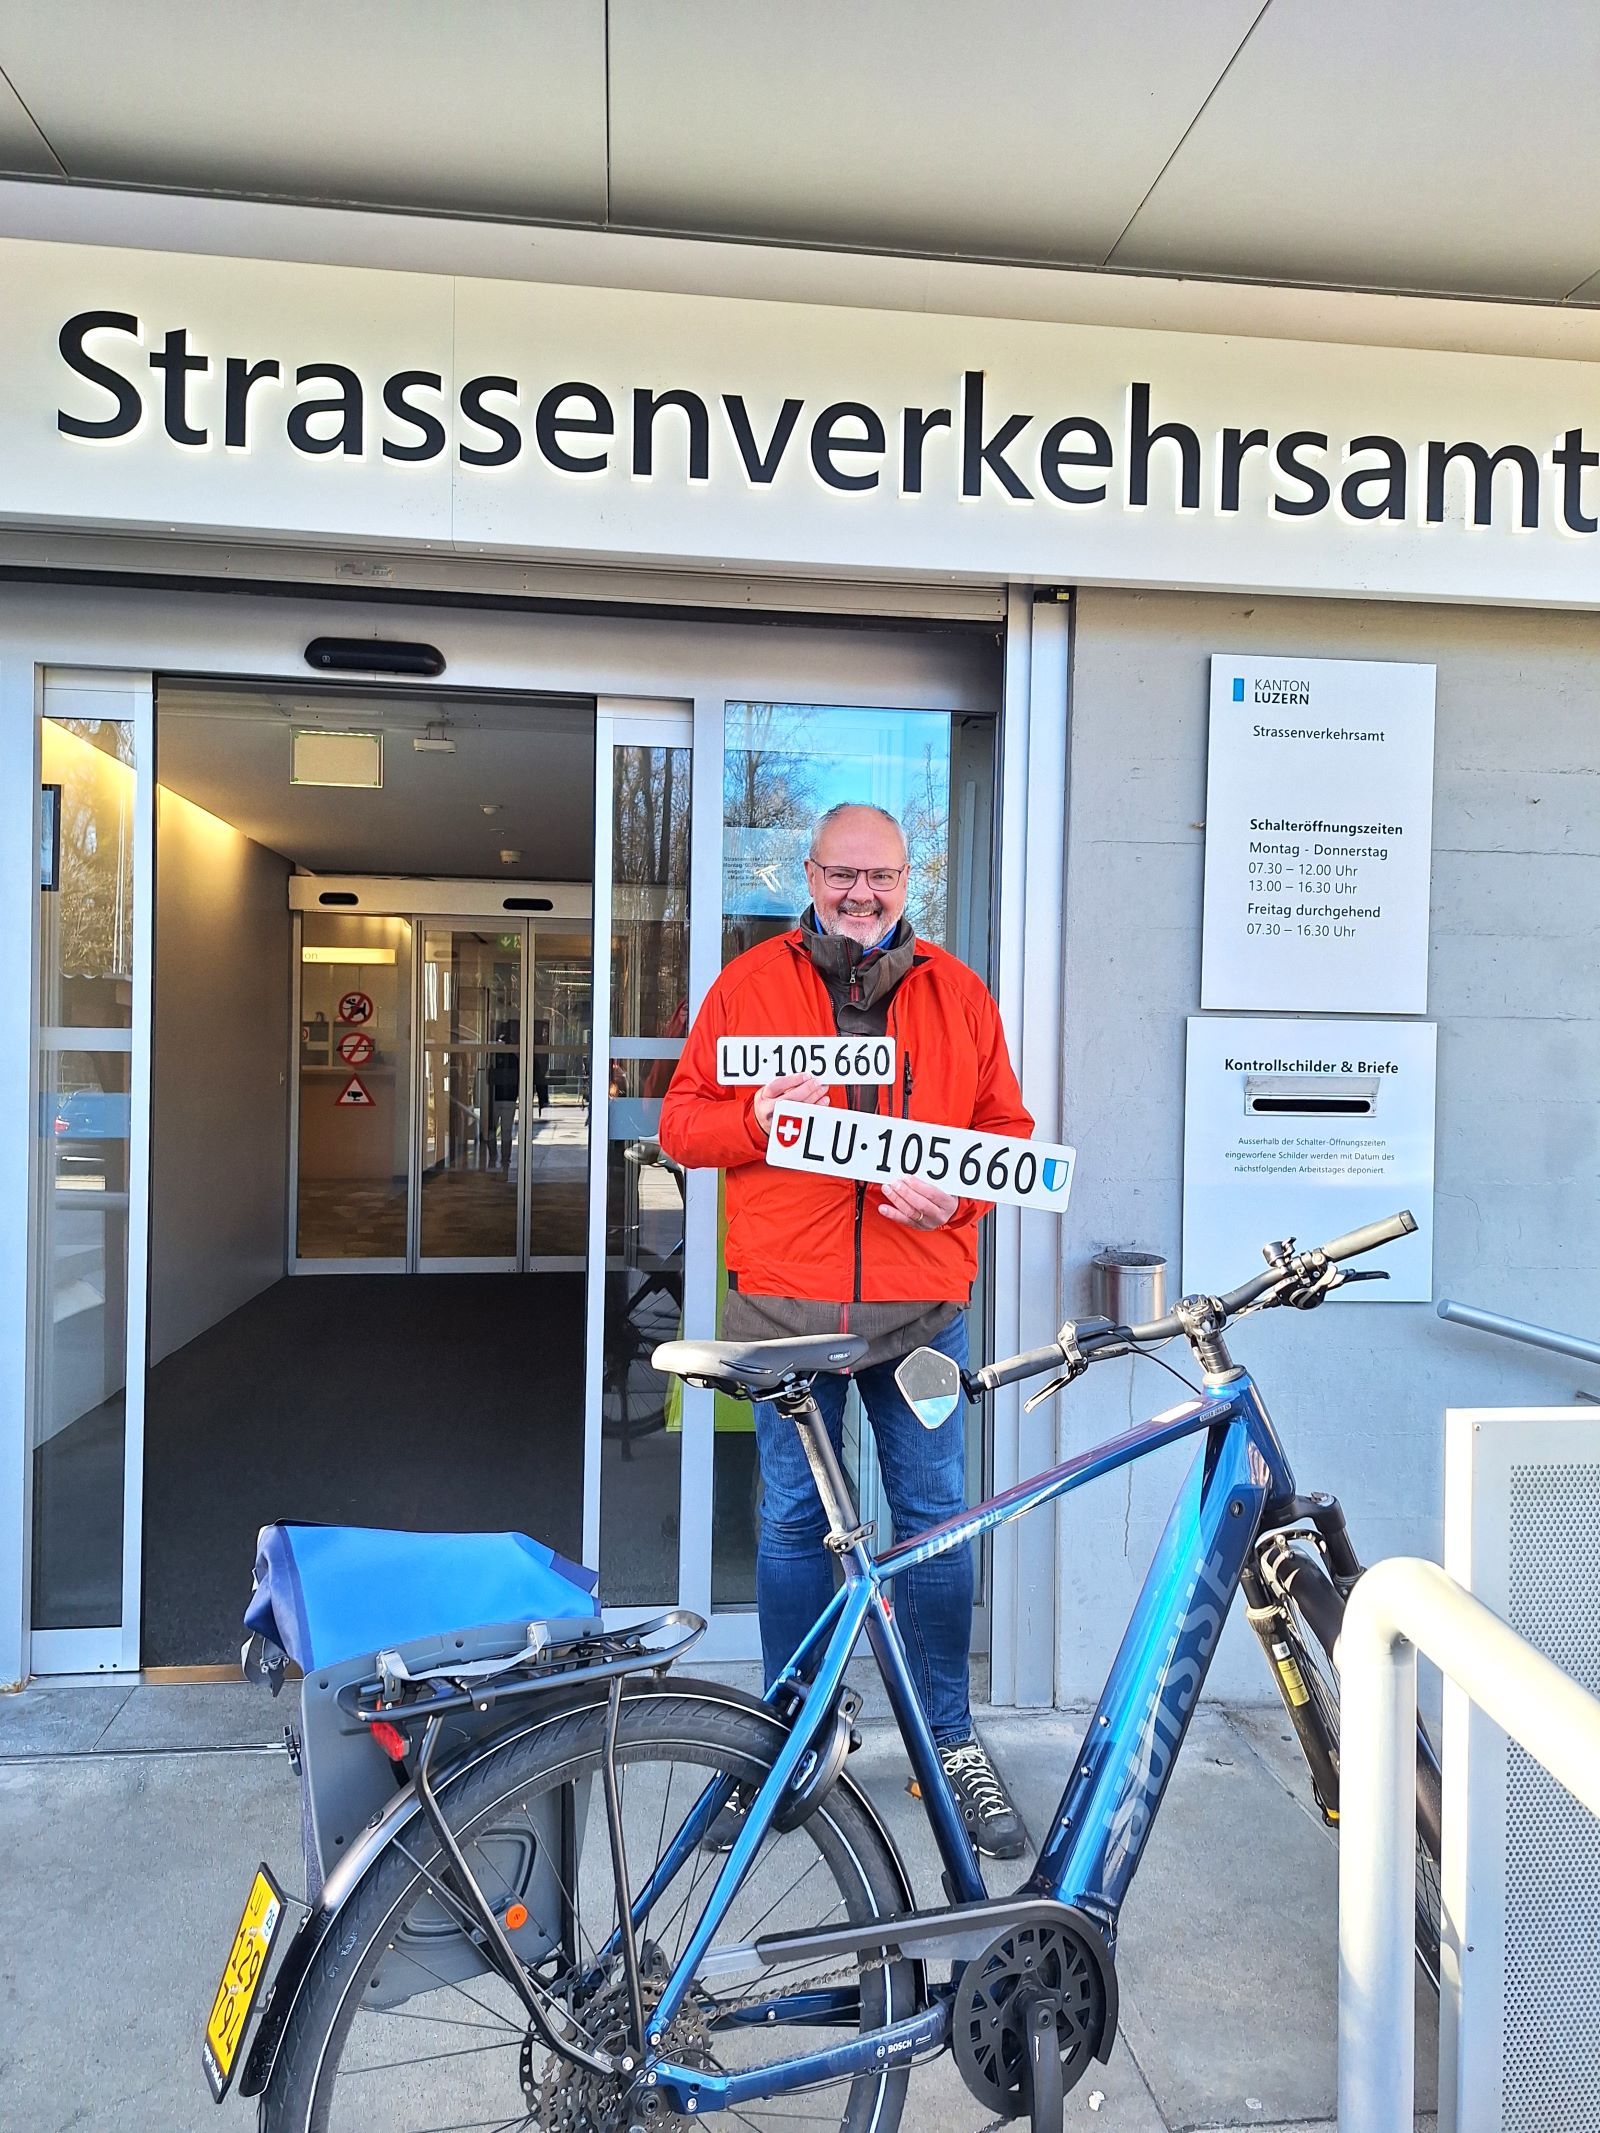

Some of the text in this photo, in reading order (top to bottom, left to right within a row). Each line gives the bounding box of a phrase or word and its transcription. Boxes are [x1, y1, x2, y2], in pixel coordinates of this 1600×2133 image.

[57, 311, 1600, 533] Strassenverkehrsamt
[1254, 679, 1310, 693] KANTON
[1254, 691, 1309, 705] LUZERN
[1253, 725, 1386, 742] Strassenverkehrsamt
[1250, 819, 1403, 836] Schalteröffnungszeiten
[1249, 842, 1300, 858] Montag
[1314, 844, 1388, 860] Donnerstag
[1248, 862, 1282, 875] 07.30
[1299, 864, 1331, 877] 12.00
[1335, 865, 1358, 877] Uhr
[1249, 880, 1282, 893] 13.00
[1298, 882, 1331, 894] 16.30
[1335, 882, 1358, 895] Uhr
[1248, 903, 1381, 920] Freitag durchgehend
[1247, 923, 1280, 936] 07.30
[1297, 925, 1329, 937] 16.30
[1334, 925, 1356, 938] Uhr
[1225, 1059, 1399, 1074] Kontrollschilder & Briefe
[1238, 1137, 1386, 1148] Ausserhalb der Schalter-Öffnungszeiten
[1225, 1151, 1277, 1160] eingeworfene
[1278, 1151, 1308, 1160] Schilder
[1310, 1152, 1338, 1160] werden
[1340, 1152, 1353, 1160] mit
[1382, 1153, 1395, 1161] des
[1234, 1165, 1386, 1176] nächstfolgenden Arbeitstages deponiert.
[1102, 1549, 1238, 1855] SUISSE
[231, 1925, 261, 1994] 129
[887, 2038, 913, 2055] BOSCH
